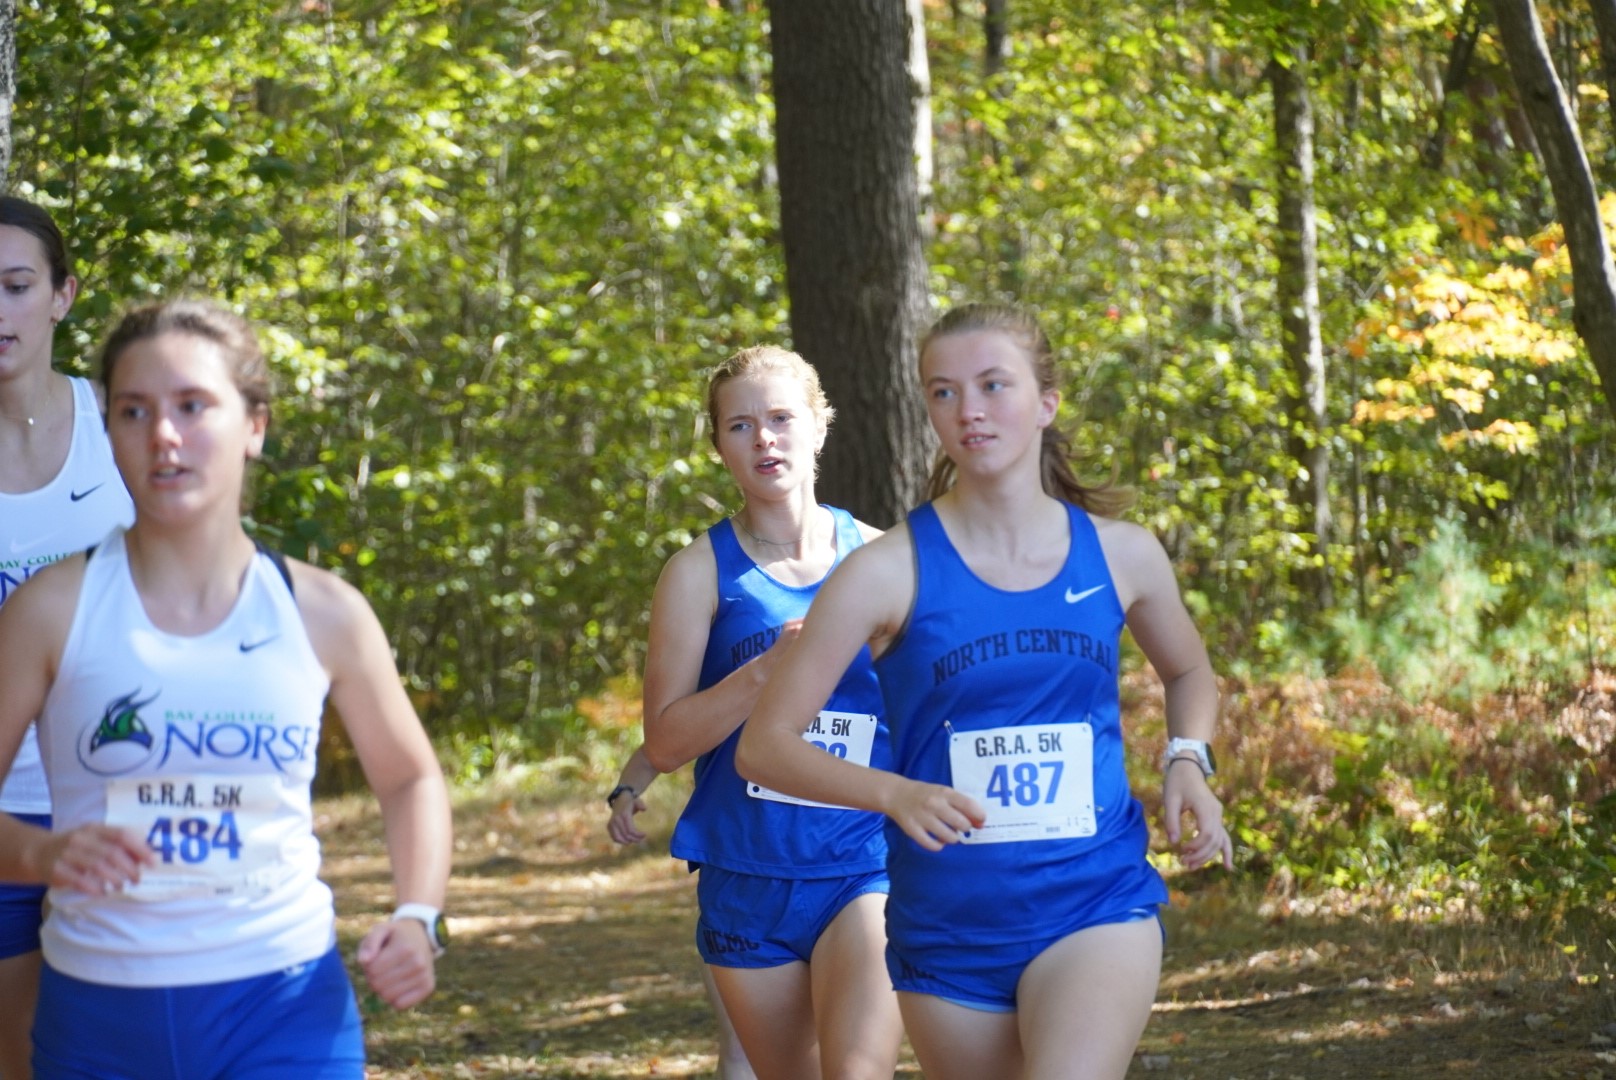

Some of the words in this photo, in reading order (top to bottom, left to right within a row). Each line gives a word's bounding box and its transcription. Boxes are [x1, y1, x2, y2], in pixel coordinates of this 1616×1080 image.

[731, 624, 784, 667] NORT
[932, 632, 1009, 686] NORTH
[1016, 628, 1112, 674] CENTRAL
[165, 710, 194, 720] BAY
[831, 718, 852, 736] 5K
[975, 735, 1031, 757] G.R.A.
[1038, 732, 1063, 753] 5K
[138, 782, 203, 808] G.R.A.
[213, 785, 242, 808] 5K
[986, 761, 1064, 807] 487
[147, 811, 242, 864] 484
